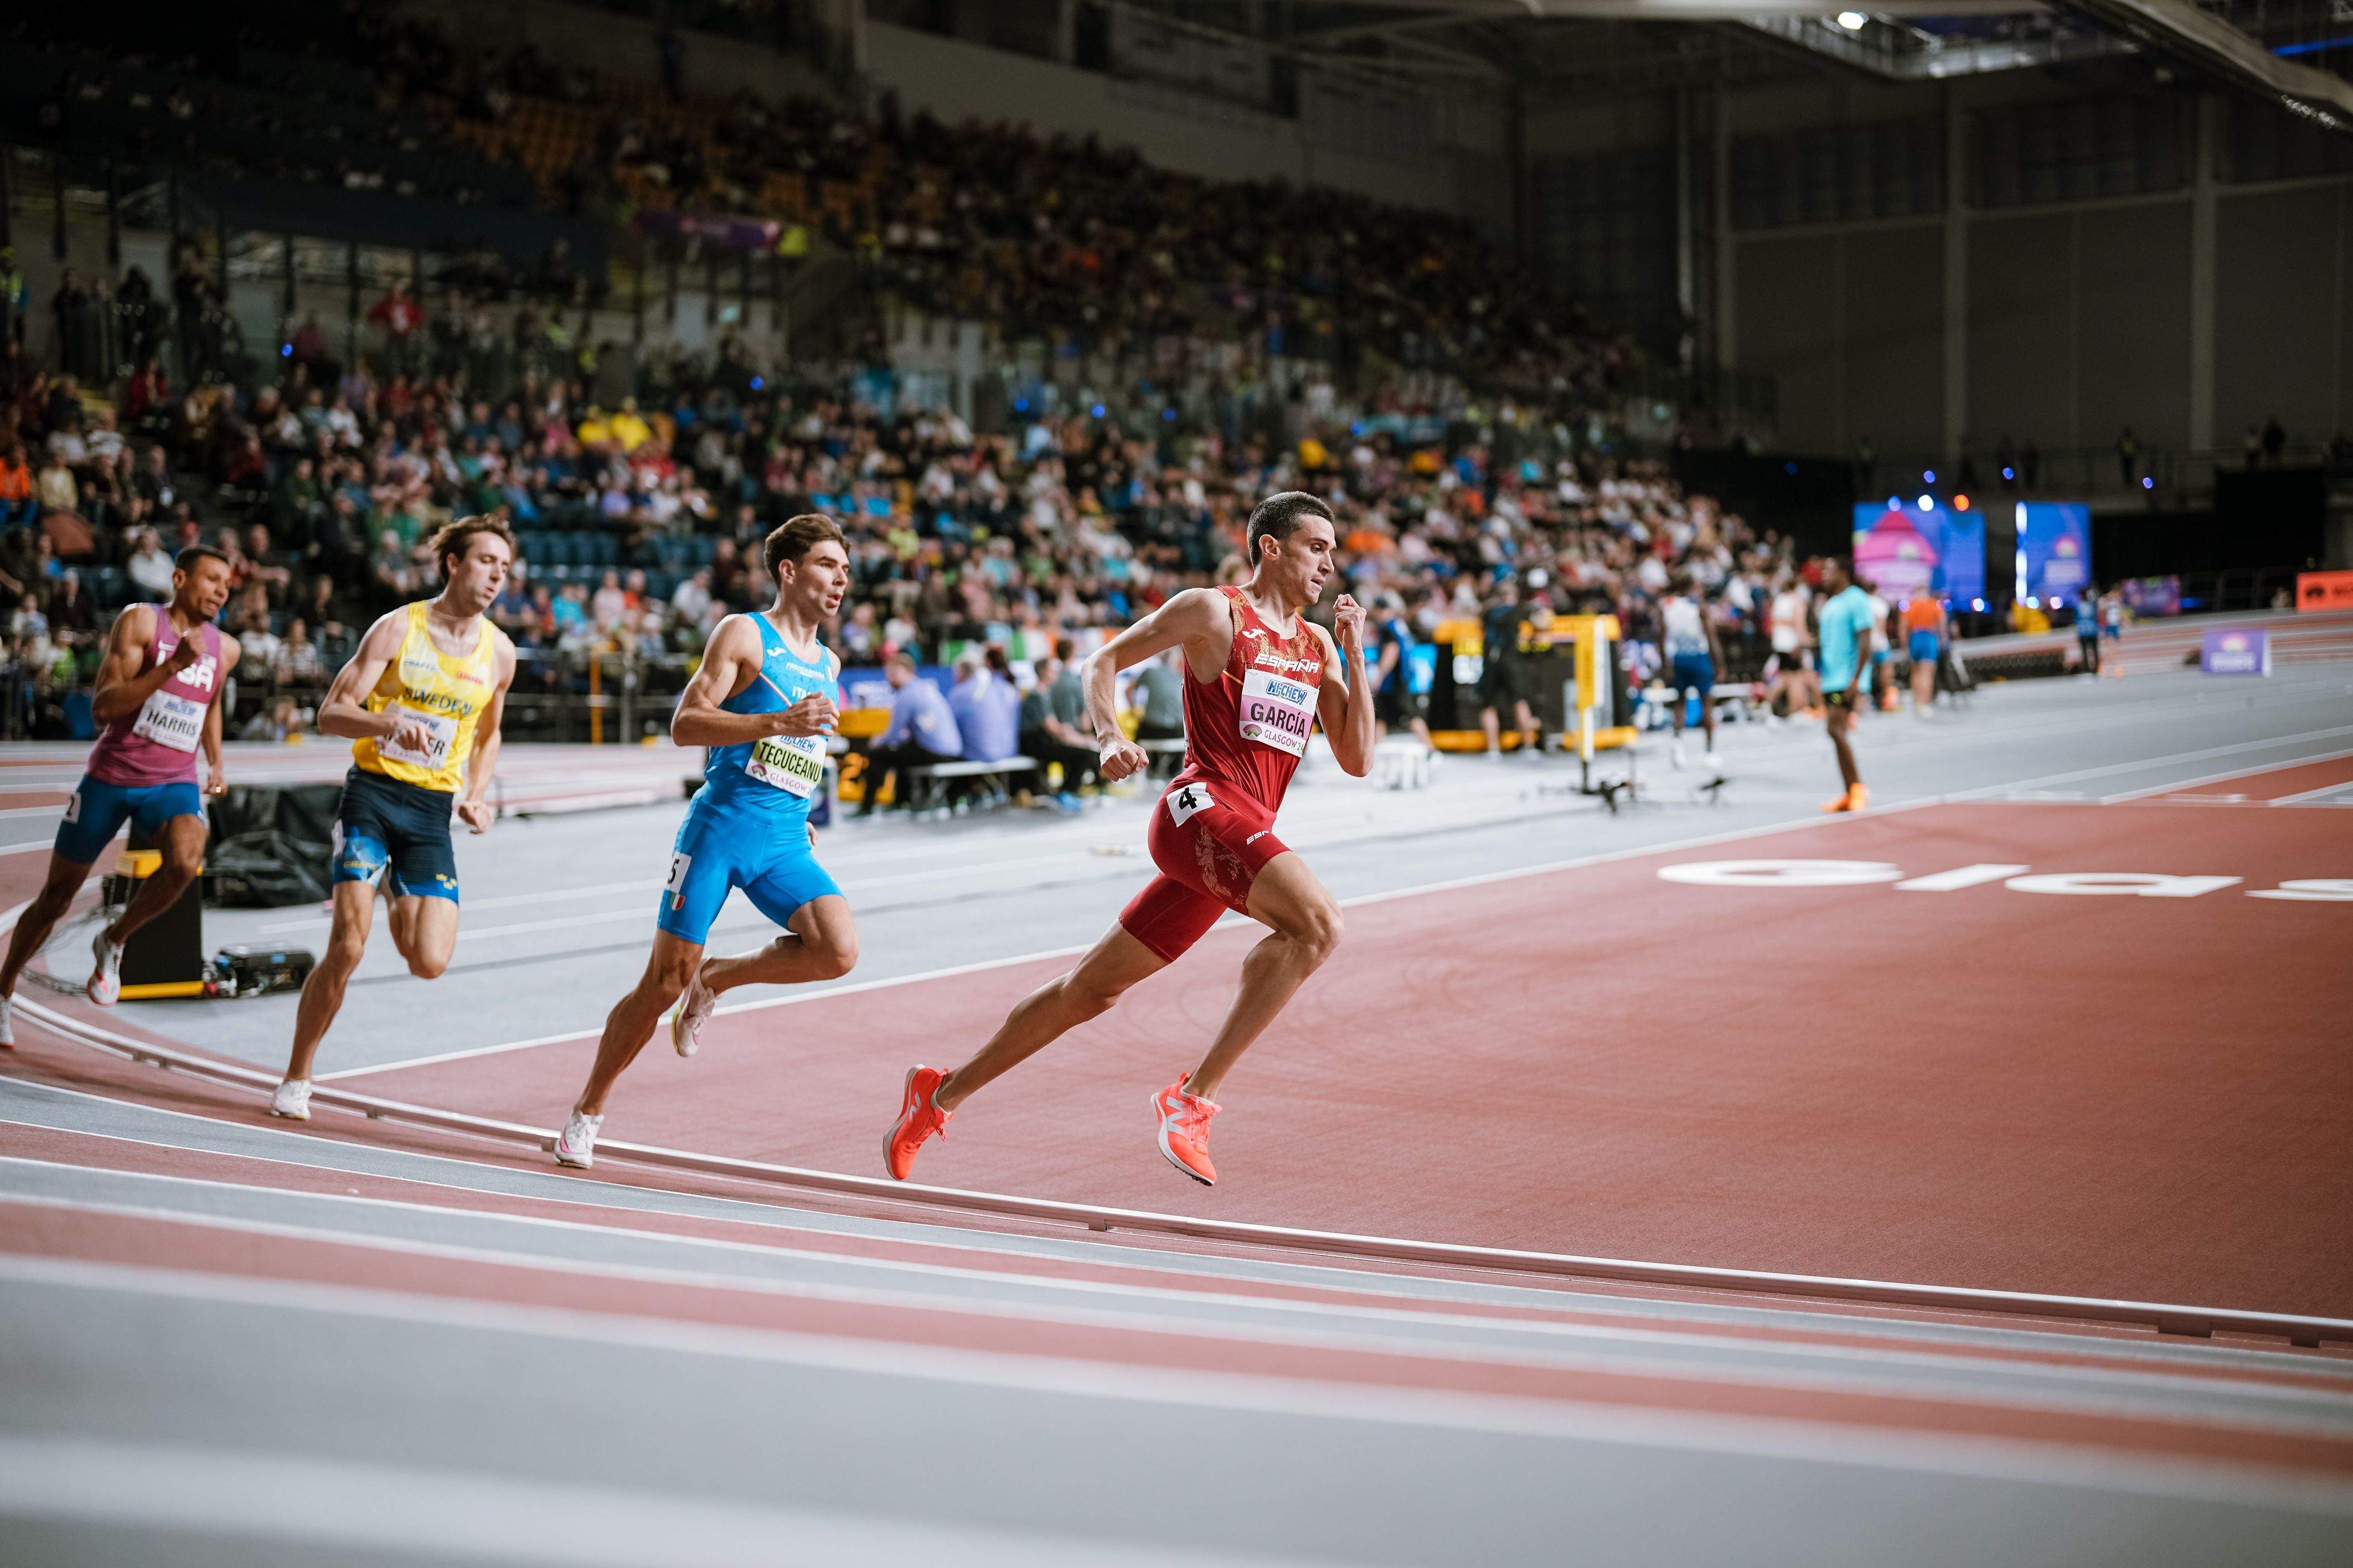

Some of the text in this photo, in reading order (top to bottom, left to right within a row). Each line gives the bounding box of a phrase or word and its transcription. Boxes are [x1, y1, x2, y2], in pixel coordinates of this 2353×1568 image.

[156, 649, 215, 693] SA
[1253, 653, 1320, 674] ESPAÑA
[403, 687, 472, 717] SWEDEN
[1266, 679, 1307, 705] HI-CHEW
[147, 708, 198, 737] HARRIS
[1251, 703, 1305, 737] GARCÍA
[1265, 729, 1297, 748] GLASGOW
[758, 742, 822, 782] TECUCEANU
[1179, 786, 1198, 810] 4
